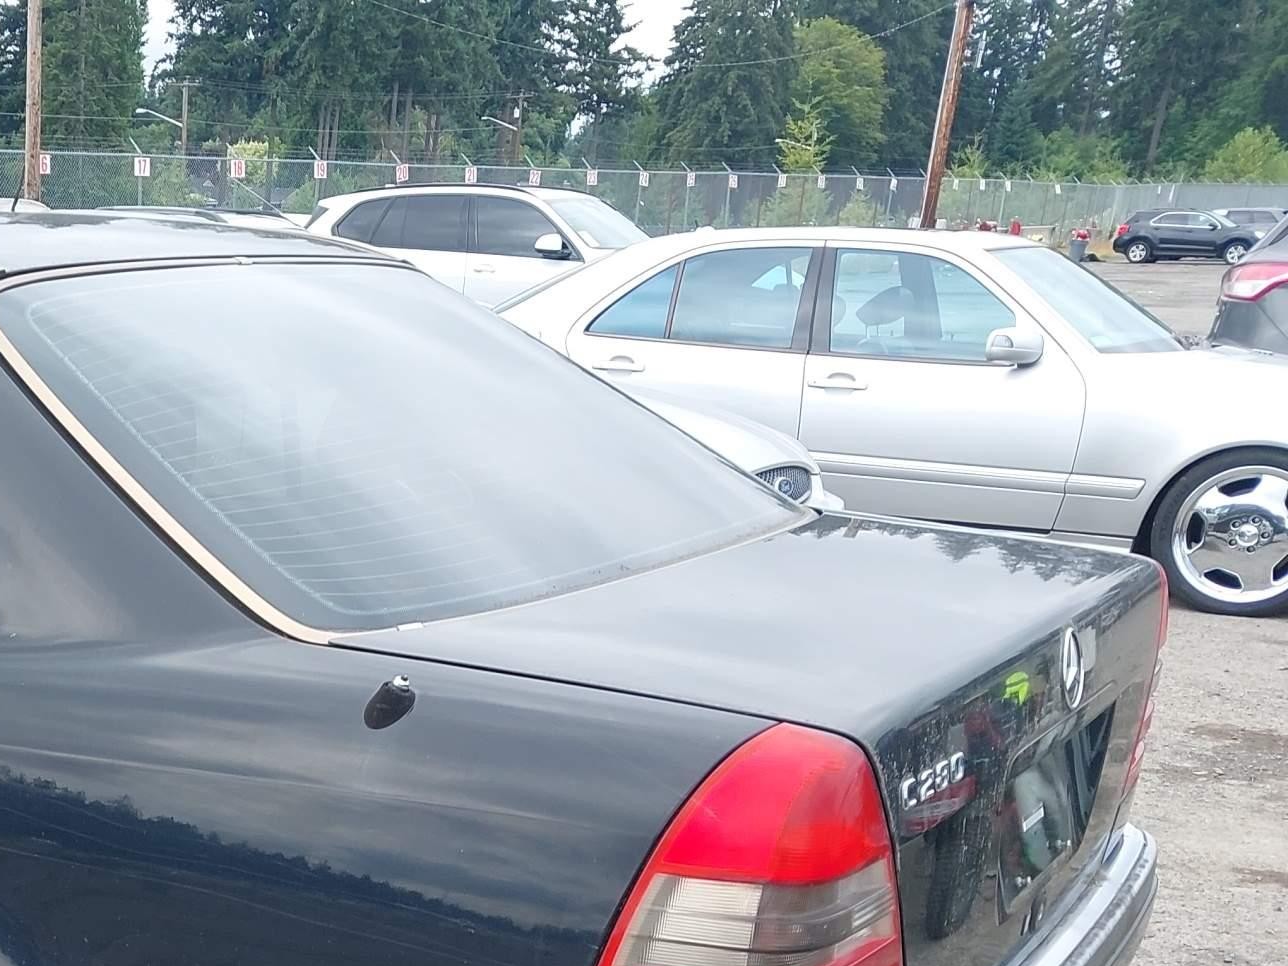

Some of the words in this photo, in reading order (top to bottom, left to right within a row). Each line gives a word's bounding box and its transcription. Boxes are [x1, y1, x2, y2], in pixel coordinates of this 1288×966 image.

[138, 159, 149, 176] 17
[233, 161, 244, 177] 18
[316, 162, 326, 178] 19
[397, 166, 408, 181] 20
[468, 169, 475, 182] 21
[531, 171, 540, 184] 22
[641, 174, 648, 184] 24
